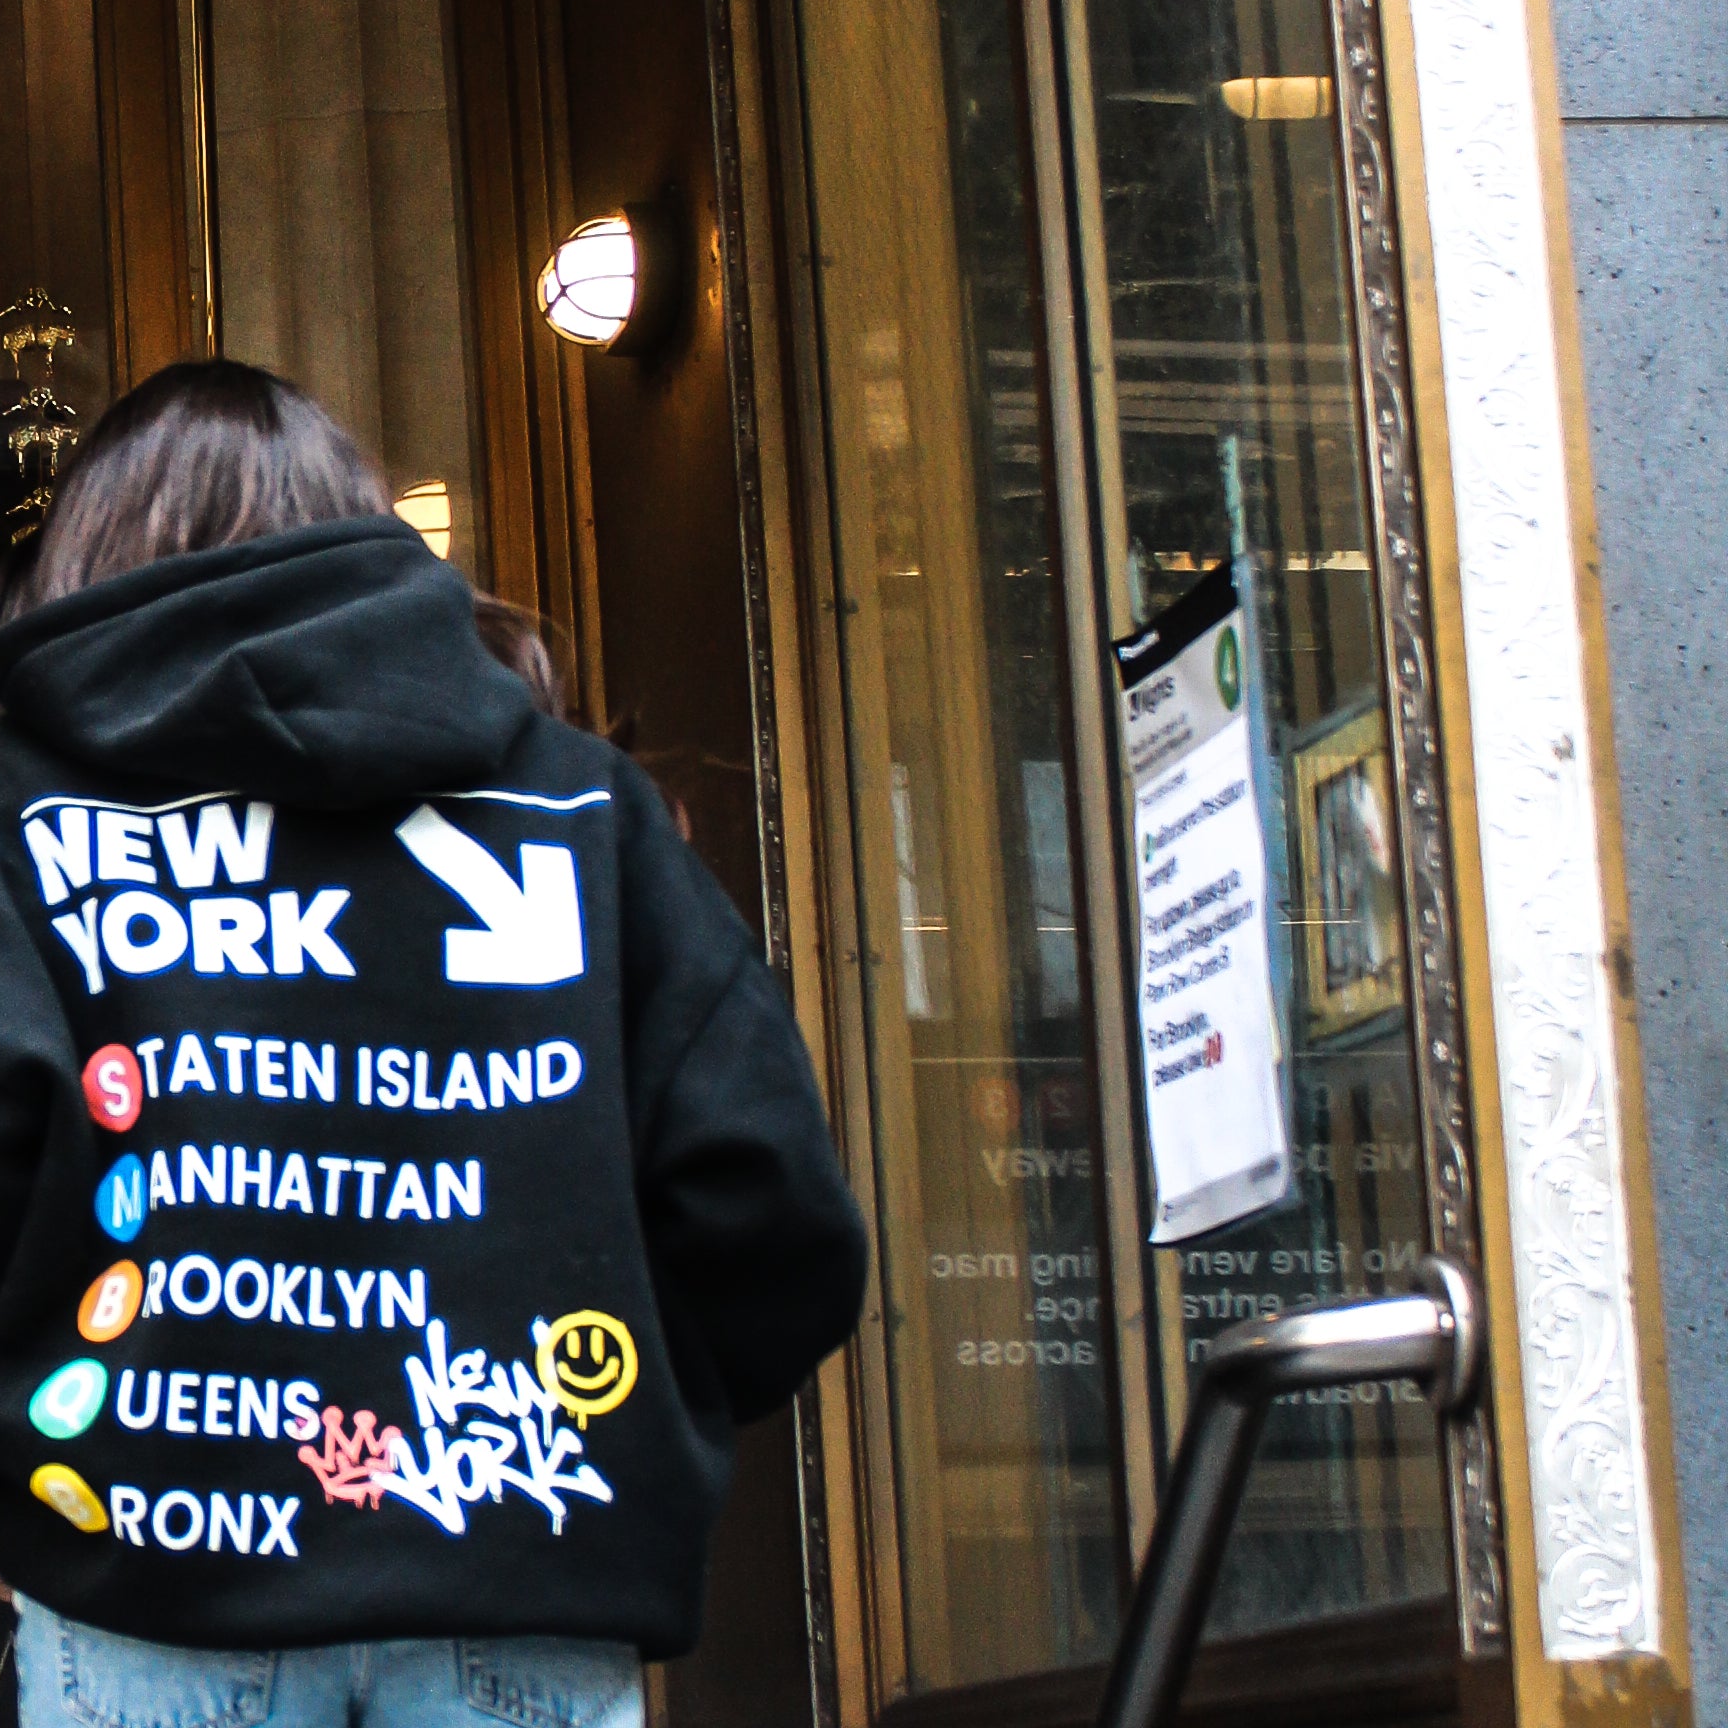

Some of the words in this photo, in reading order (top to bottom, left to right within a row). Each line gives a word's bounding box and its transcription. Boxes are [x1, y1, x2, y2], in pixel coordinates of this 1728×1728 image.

[23, 801, 275, 906] NEW
[50, 886, 357, 995] YORK
[97, 1033, 336, 1118] STATEN
[358, 1039, 583, 1111] ISLAND
[90, 1253, 426, 1330] BROOKLYN
[45, 1366, 322, 1442] QUEENS
